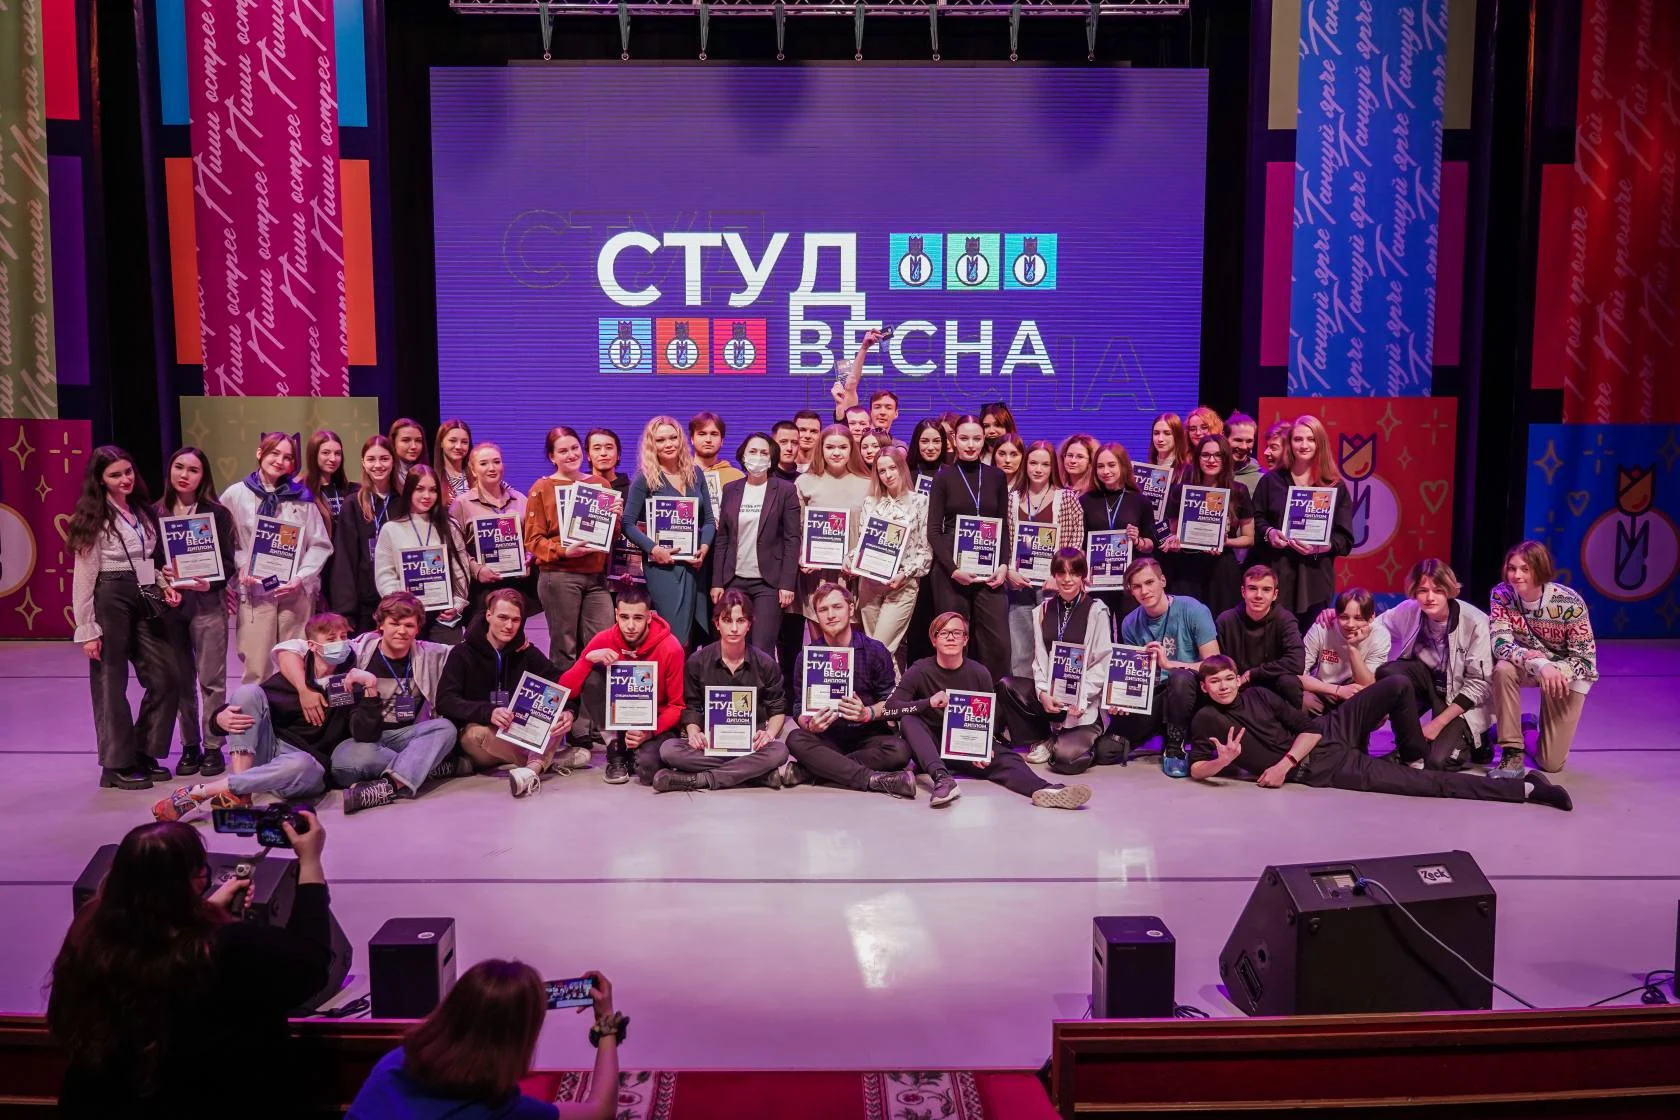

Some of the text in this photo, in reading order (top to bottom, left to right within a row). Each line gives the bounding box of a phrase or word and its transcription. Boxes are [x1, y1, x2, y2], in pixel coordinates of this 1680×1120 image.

[201, 12, 227, 102] острее
[1319, 59, 1344, 118] ярче
[224, 53, 265, 167] Пиши
[193, 112, 234, 224] Пиши
[1349, 171, 1374, 229] ярче
[255, 171, 280, 260] острее
[278, 114, 318, 322] Пиши острее
[1314, 229, 1339, 287] ярче
[224, 228, 248, 316] острее
[597, 231, 866, 320] СТУД
[245, 268, 287, 378] Пиши
[309, 326, 330, 397] стрее
[789, 319, 1055, 376] ВЕСНА
[1134, 475, 1152, 488] ТУД
[1420, 868, 1451, 881] Zeck
